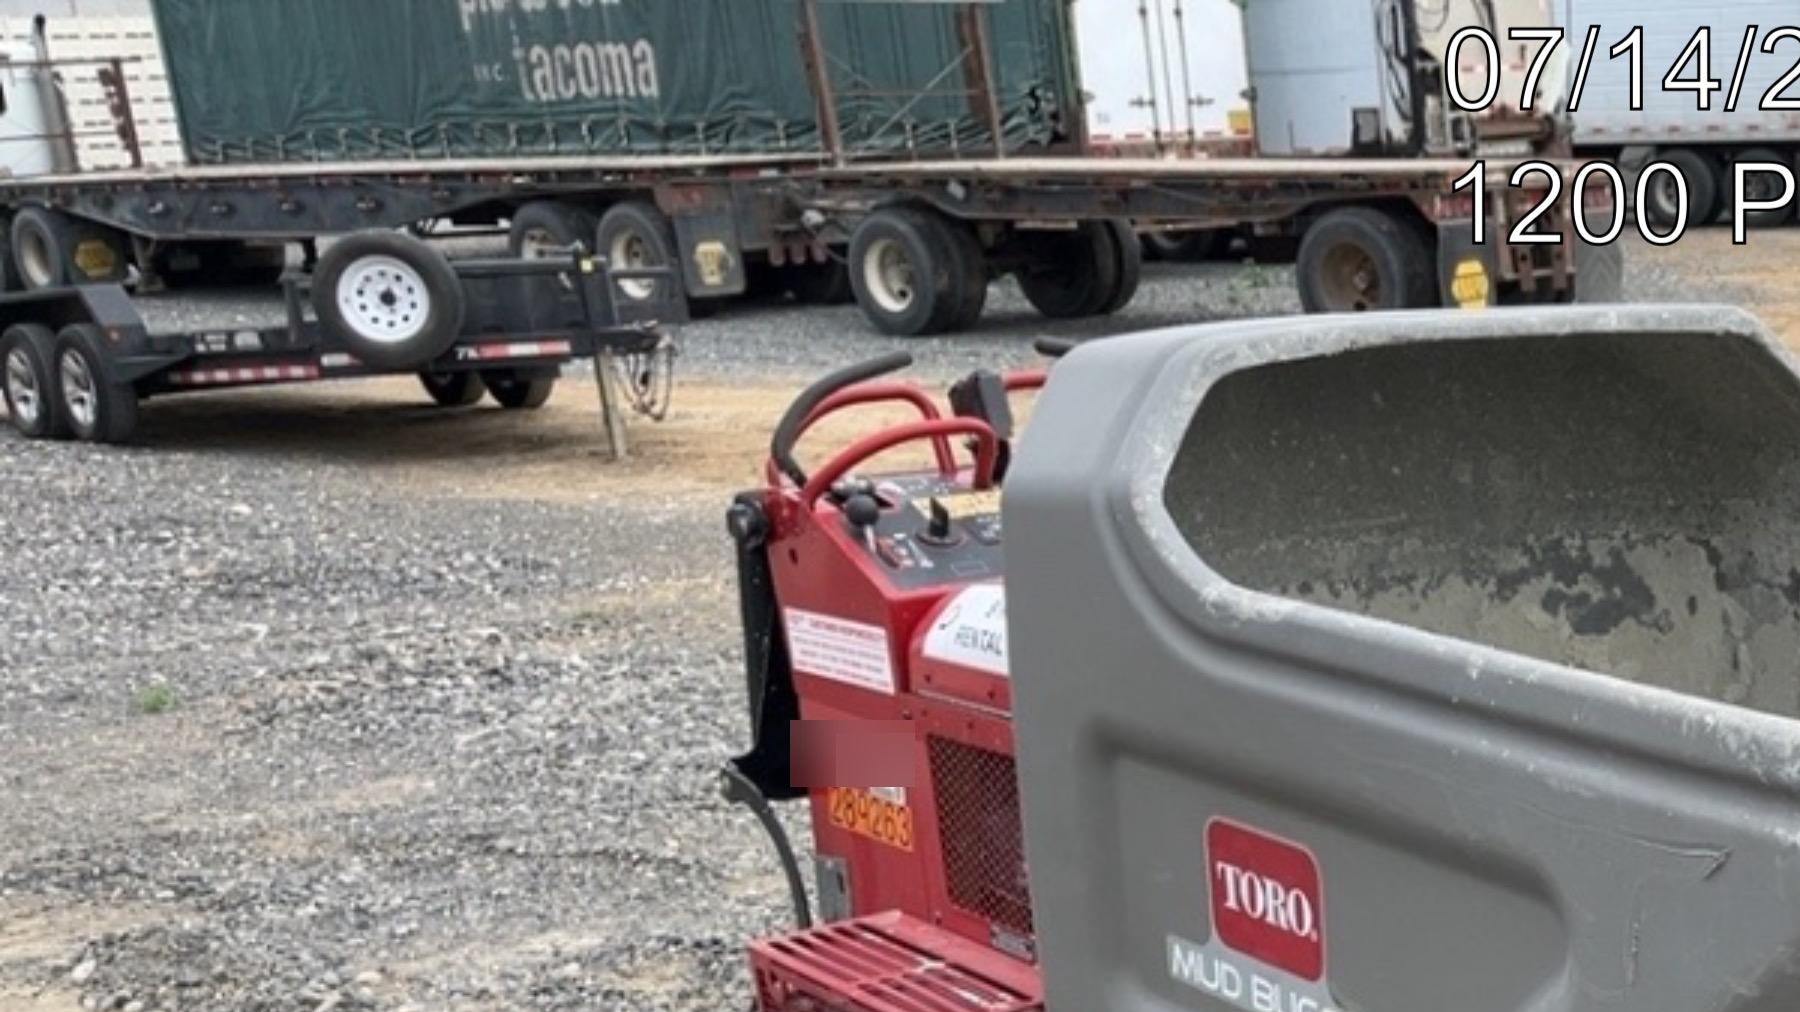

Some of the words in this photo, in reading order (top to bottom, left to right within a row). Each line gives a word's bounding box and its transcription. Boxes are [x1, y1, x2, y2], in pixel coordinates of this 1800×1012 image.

[513, 38, 660, 101] tacoma
[1216, 861, 1314, 938] TORO
[1171, 943, 1243, 999] MUD
